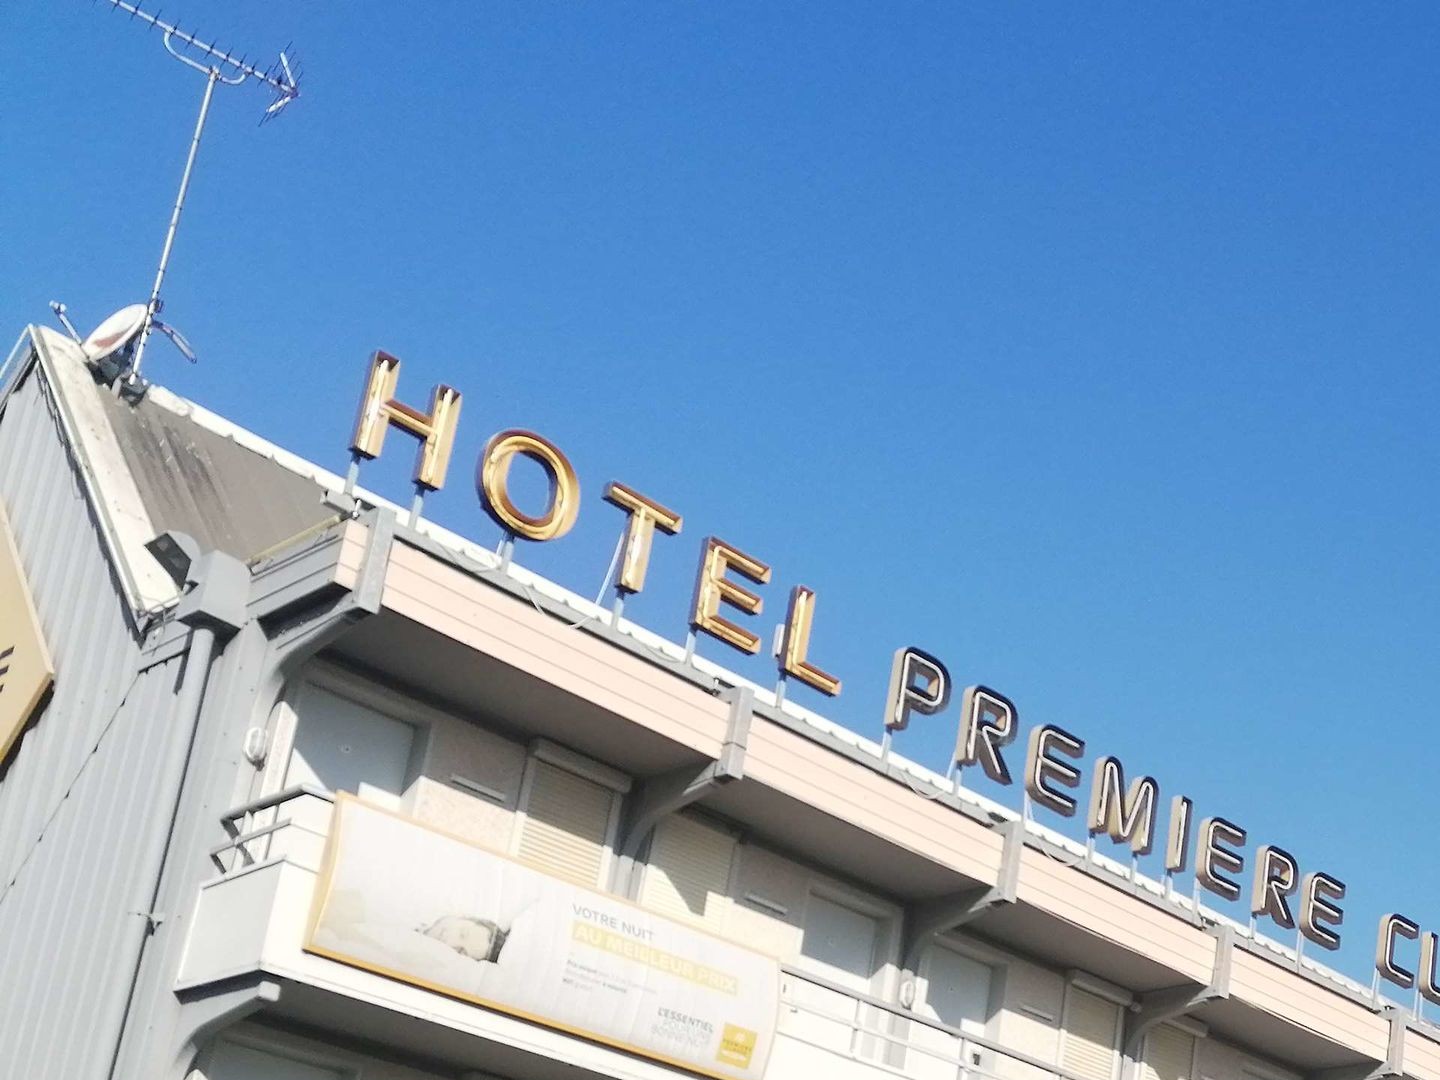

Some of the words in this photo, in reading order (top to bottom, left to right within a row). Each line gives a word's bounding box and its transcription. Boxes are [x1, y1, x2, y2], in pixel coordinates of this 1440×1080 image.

[349, 350, 842, 697] HOTEL
[883, 646, 1346, 951] PREMIERE
[572, 903, 618, 929] VOTRE
[622, 921, 655, 941] NUIT
[574, 923, 602, 944] AU
[606, 933, 695, 978] MEILLEUR
[696, 965, 736, 993] PRIX
